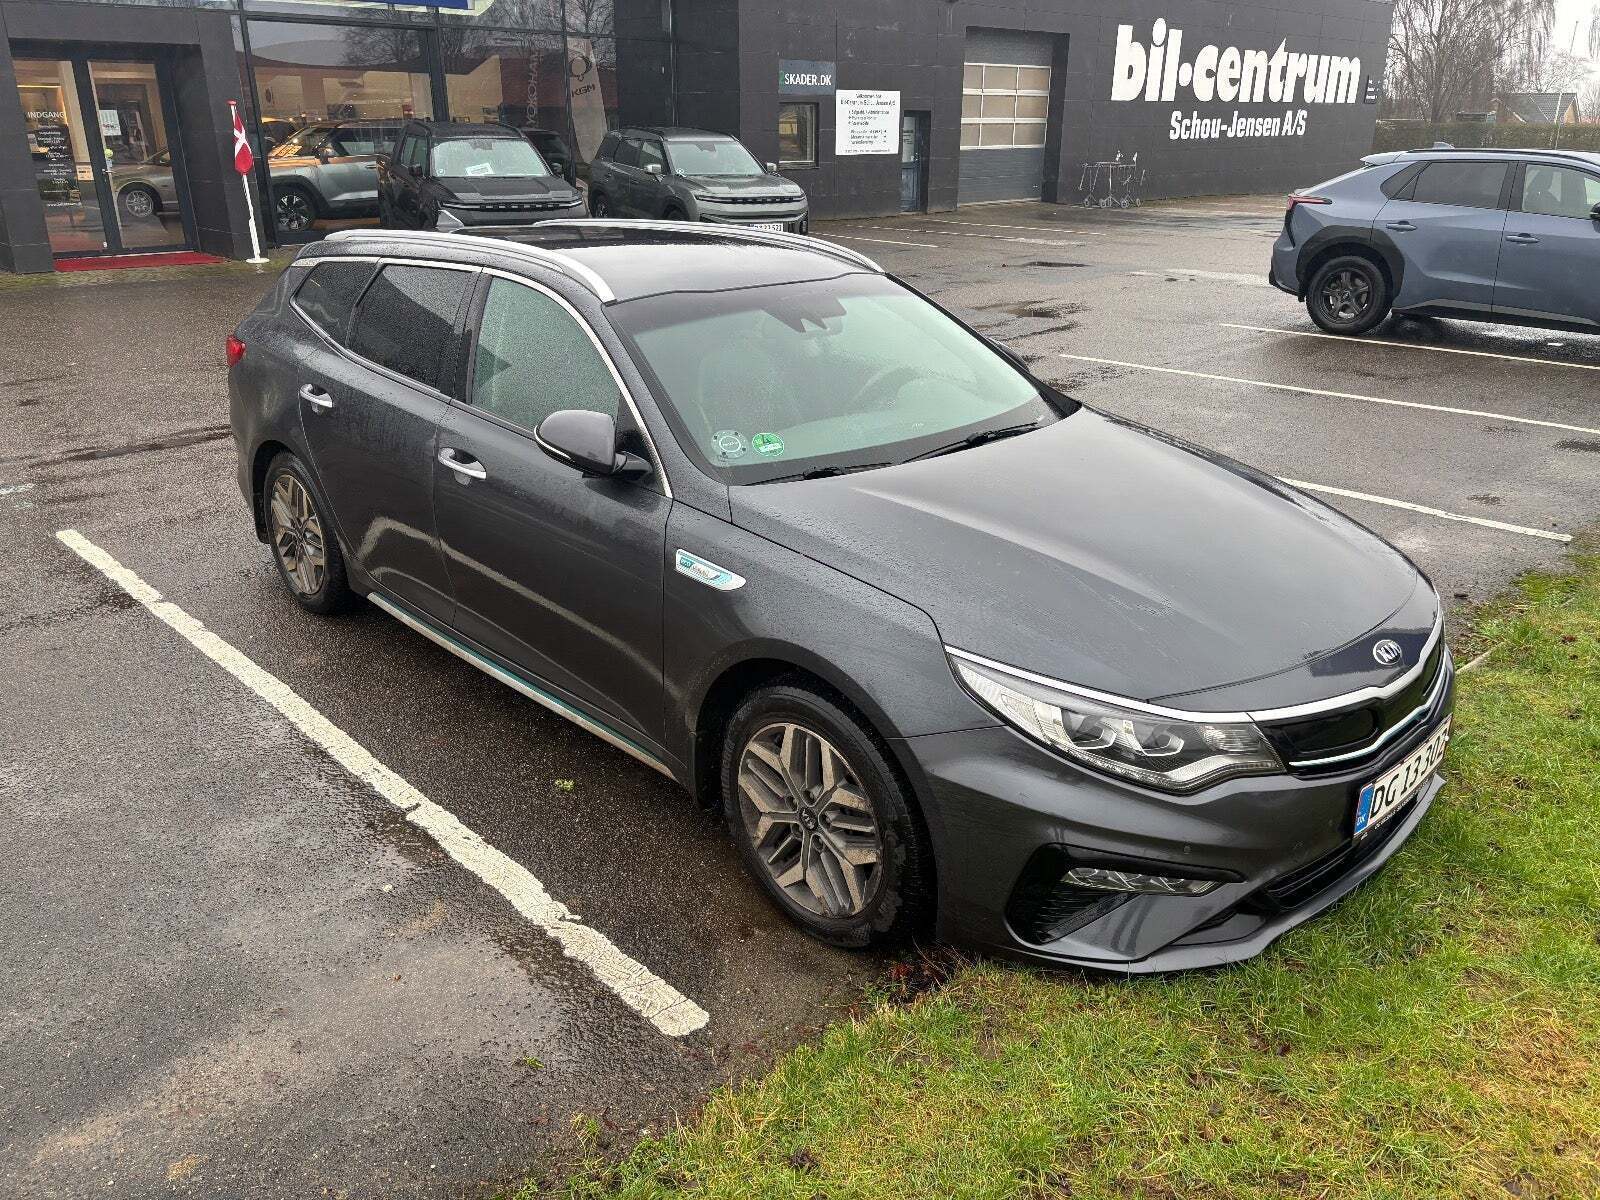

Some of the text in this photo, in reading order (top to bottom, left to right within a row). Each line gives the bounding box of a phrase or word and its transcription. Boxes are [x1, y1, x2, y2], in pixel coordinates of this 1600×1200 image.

[571, 83, 596, 98] KGM
[27, 111, 65, 119] INDGANG
[1169, 108, 1308, 140] Schou-Jensen A/S
[1375, 640, 1402, 663] KIA
[1369, 773, 1399, 818] DG
[1400, 762, 1419, 795] 13
